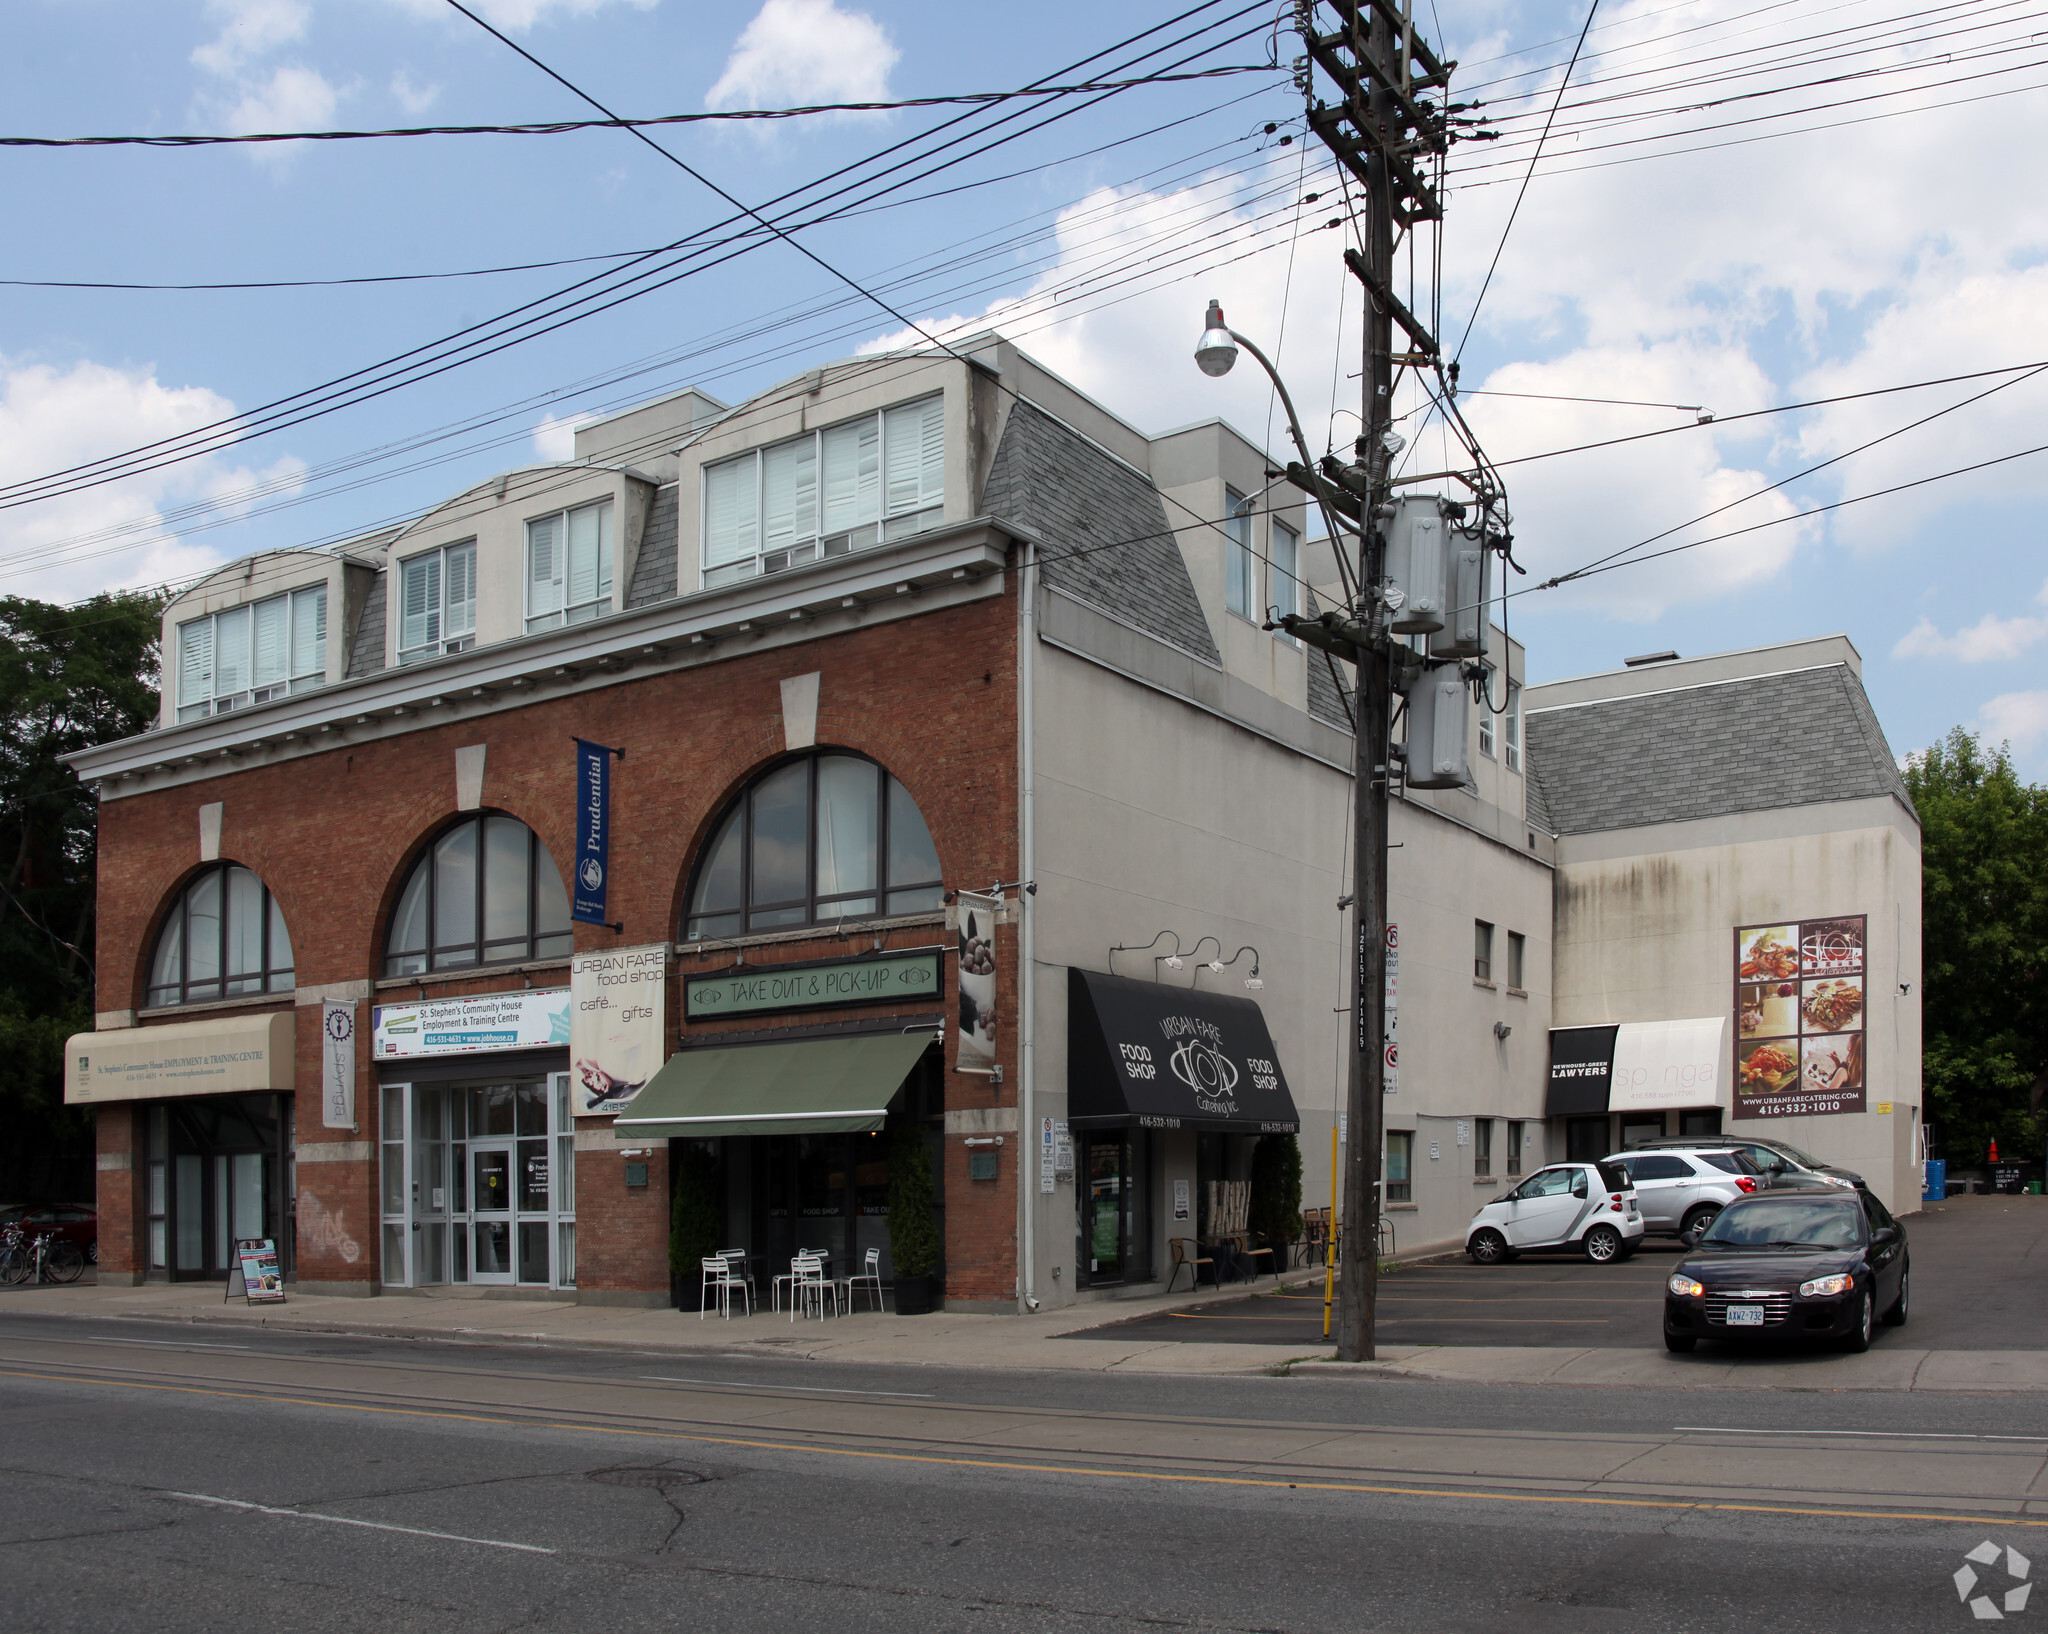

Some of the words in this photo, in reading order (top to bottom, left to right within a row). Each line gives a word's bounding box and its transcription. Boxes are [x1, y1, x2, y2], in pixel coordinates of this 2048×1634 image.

[588, 754, 601, 853] Prudential
[572, 956, 624, 974] URBAN
[626, 952, 664, 969] FARE
[597, 971, 627, 986] food
[630, 968, 663, 984] shop
[730, 980, 766, 1003] TAKE
[772, 976, 804, 1000] OUT
[808, 976, 820, 996] &
[826, 968, 890, 994] PICK-UP
[420, 1010, 429, 1018] St.
[430, 1006, 461, 1019] Stephen's
[462, 1003, 500, 1015] Community
[501, 1001, 522, 1011] House
[622, 1006, 653, 1022] gifts
[423, 1019, 461, 1030] Employment
[462, 1018, 468, 1026] &
[470, 1014, 496, 1026] Training
[498, 1013, 520, 1023] Centre
[1158, 1015, 1197, 1040] URBAN
[1195, 1018, 1223, 1045] FARE
[427, 1035, 461, 1043] 416-531-4631
[467, 1034, 514, 1043] www.jobhouse.ca
[1119, 1043, 1152, 1062] FOOD
[104, 1064, 123, 1075] Stephen's
[123, 1063, 148, 1072] Community
[150, 1061, 163, 1069] House
[164, 1056, 202, 1068] EMPLOYMENT
[203, 1056, 209, 1065] &
[210, 1052, 239, 1064] TRAINING
[239, 1050, 264, 1061] CENTRE
[1126, 1061, 1156, 1080] SHOP
[1247, 1058, 1274, 1074] FOOD
[1553, 1061, 1608, 1069] NEWHOUSE-GREEN
[1552, 1067, 1608, 1078] LAWYERS
[1253, 1074, 1278, 1090] SHOP
[1196, 1095, 1229, 1118] Catering
[1743, 1093, 1859, 1106] WWW.URBANFARECATERING.COM
[1139, 1116, 1180, 1128] 416-532-1010
[1260, 1122, 1294, 1132] 416-532-1010
[863, 1206, 879, 1214] TAKE
